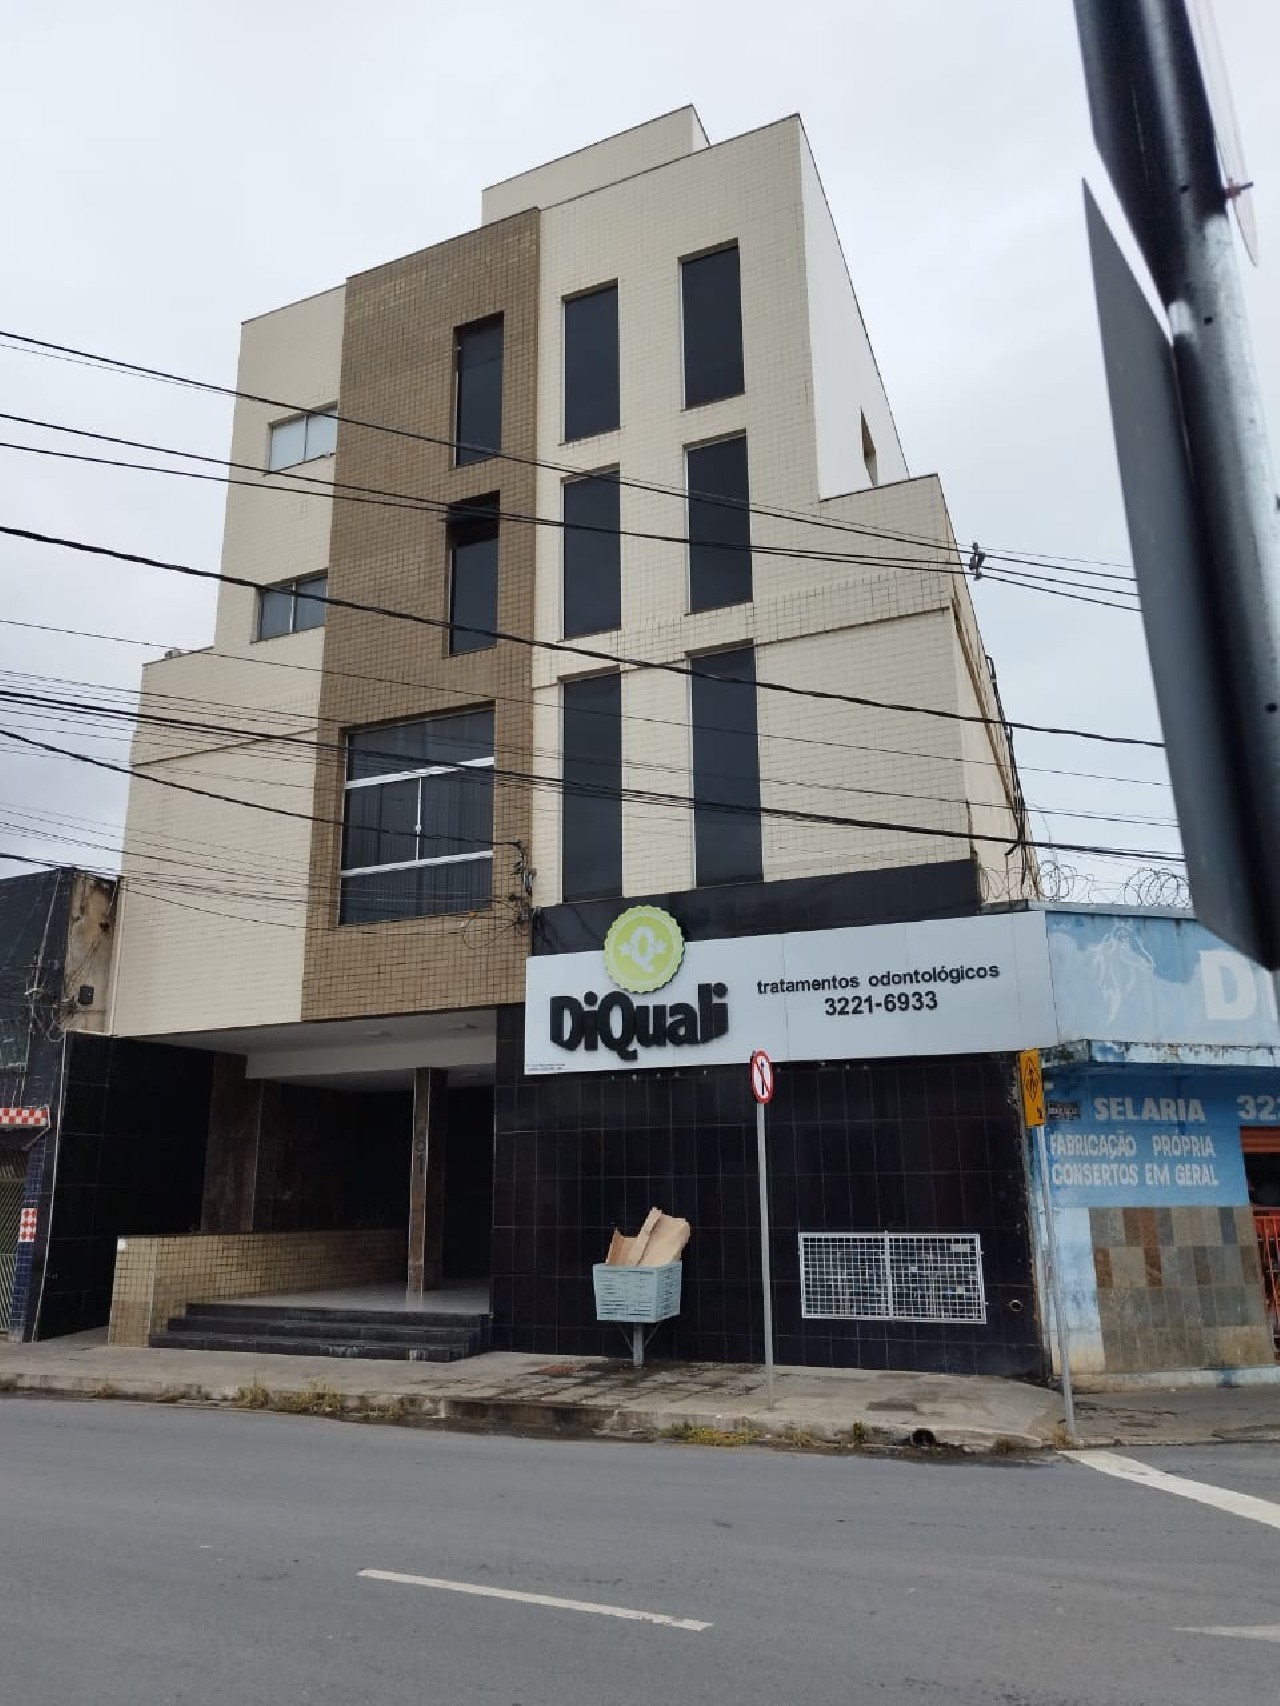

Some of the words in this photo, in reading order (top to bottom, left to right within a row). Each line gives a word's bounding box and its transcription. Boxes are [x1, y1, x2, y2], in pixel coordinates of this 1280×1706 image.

[757, 975, 860, 995] tratamentos
[868, 965, 1001, 987] odontológicos
[824, 990, 939, 1016] 3221-6933
[550, 982, 729, 1061] DiQuali
[1094, 1097, 1206, 1121] SELARIA
[1051, 1129, 1137, 1160] FABRICAÇÃO
[1152, 1130, 1217, 1157] PRÓPRIA
[1052, 1163, 1139, 1186] CONSERTOS
[1145, 1164, 1171, 1186] EM
[1175, 1163, 1219, 1186] GERAL
